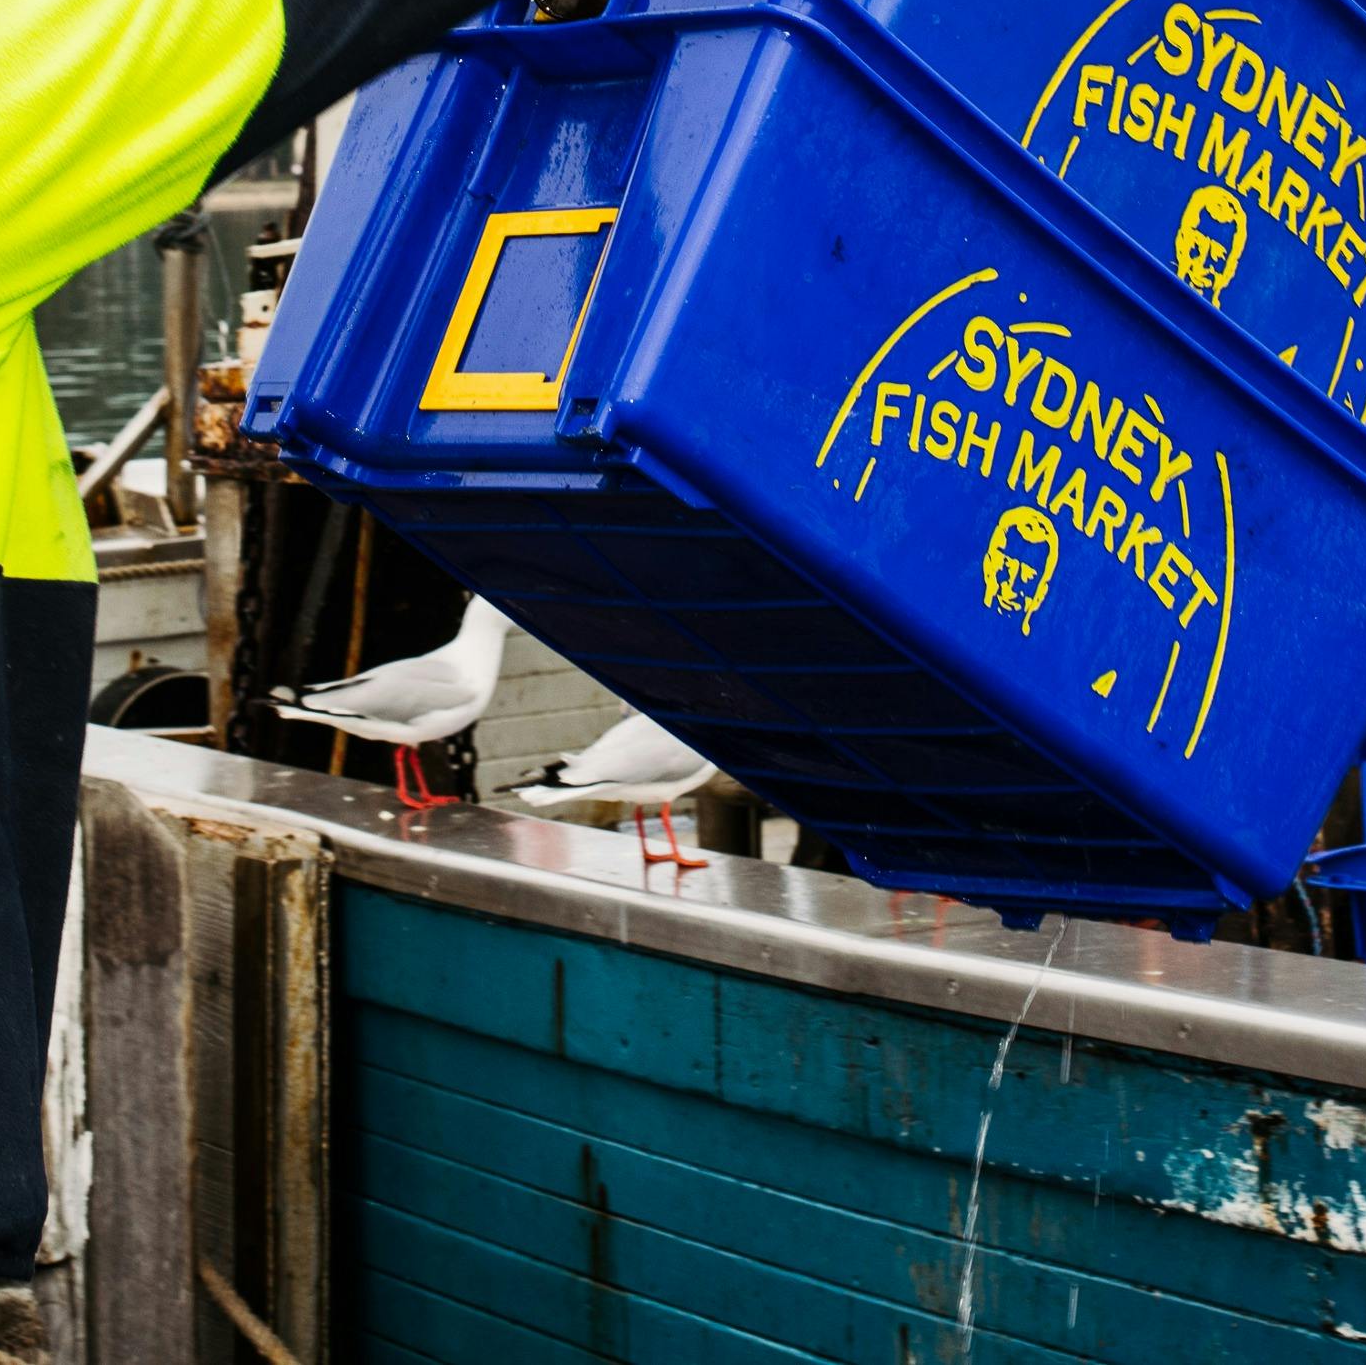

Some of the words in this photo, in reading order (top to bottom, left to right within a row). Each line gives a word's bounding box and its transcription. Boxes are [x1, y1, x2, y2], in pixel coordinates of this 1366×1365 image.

[1072, 64, 1197, 161] FISH
[954, 315, 1193, 503] SYDNEY
[870, 381, 1003, 478] FISH
[1007, 429, 1219, 630] MARKET
